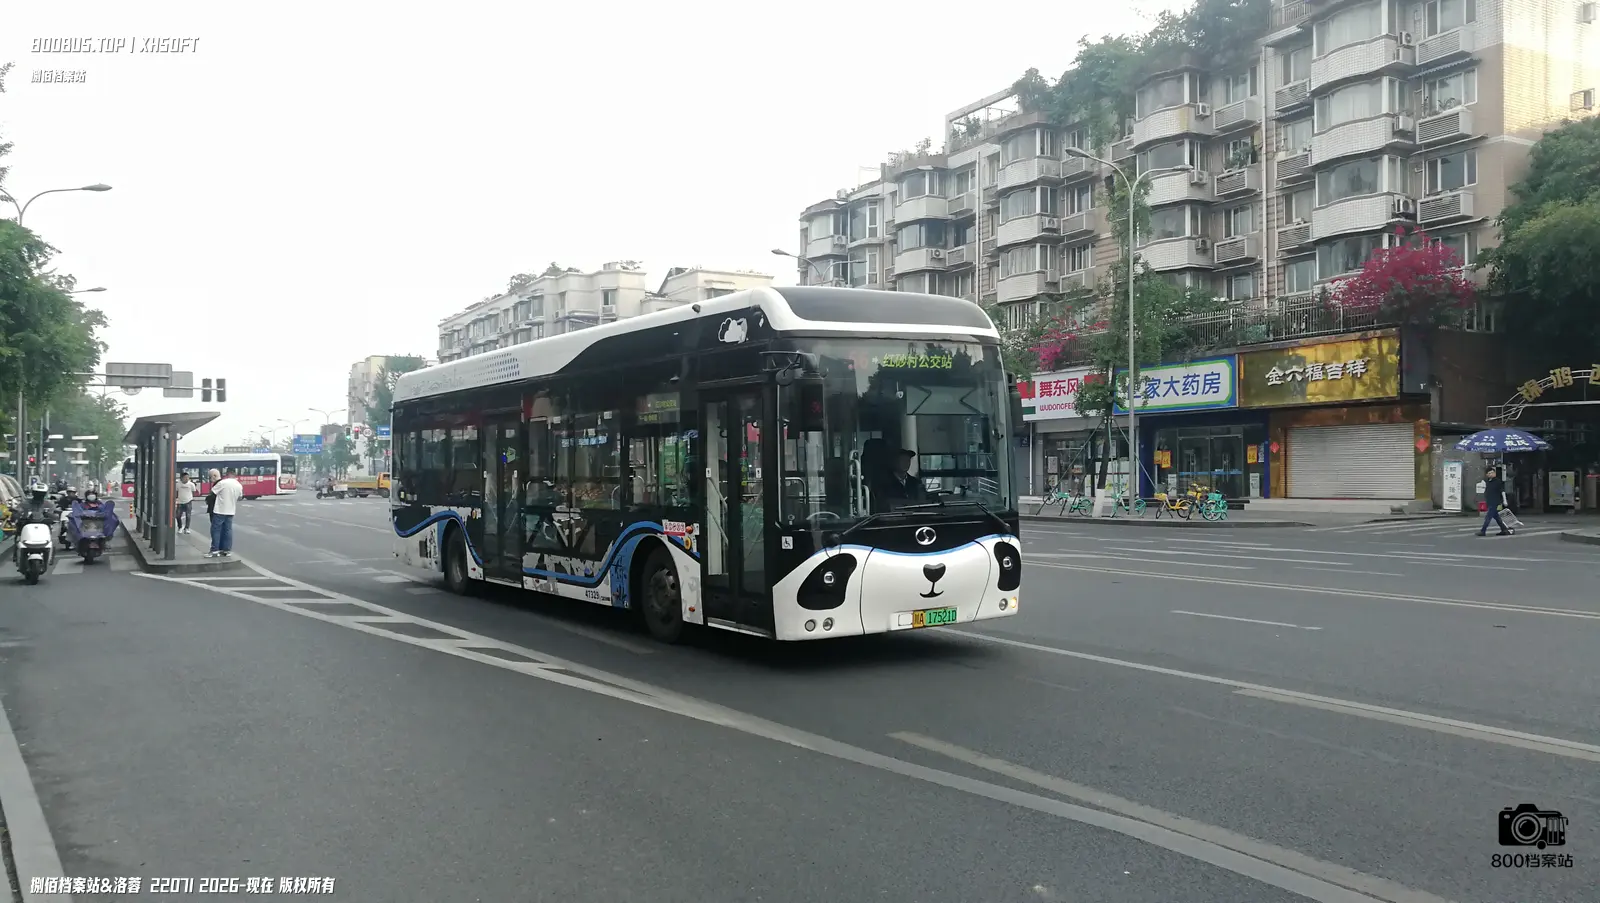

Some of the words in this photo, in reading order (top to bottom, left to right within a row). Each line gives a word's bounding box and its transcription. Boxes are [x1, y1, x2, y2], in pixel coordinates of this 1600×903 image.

[882, 352, 953, 369] 红砂村公交站
[1265, 357, 1370, 386] 金六福吉祥
[1039, 377, 1078, 398] 舞东风
[1127, 371, 1221, 401] 家大药房
[928, 608, 957, 624] 17521D
